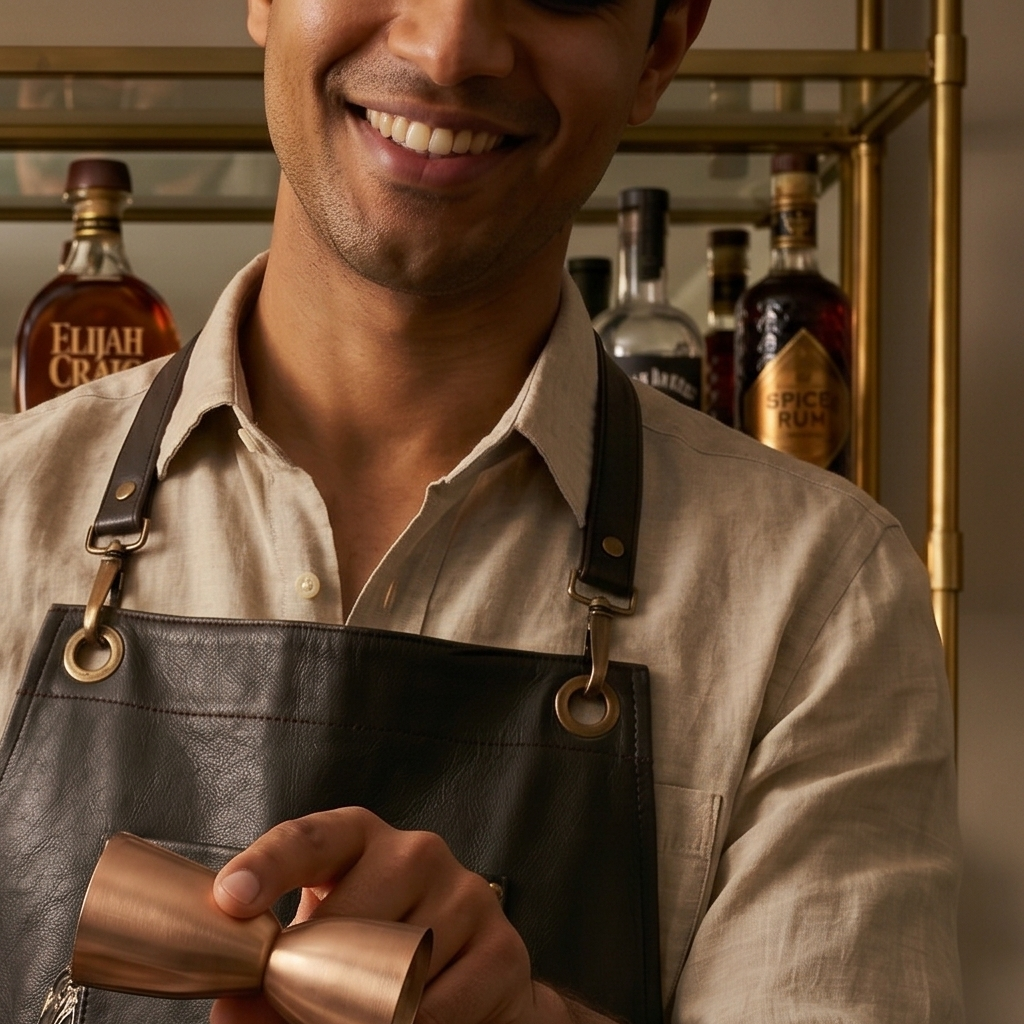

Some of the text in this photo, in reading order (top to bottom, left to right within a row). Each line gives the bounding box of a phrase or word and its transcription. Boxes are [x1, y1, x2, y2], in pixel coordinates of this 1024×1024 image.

[49, 322, 144, 359] ELIJAH
[48, 353, 142, 388] CRA
[778, 411, 825, 428] RUM
